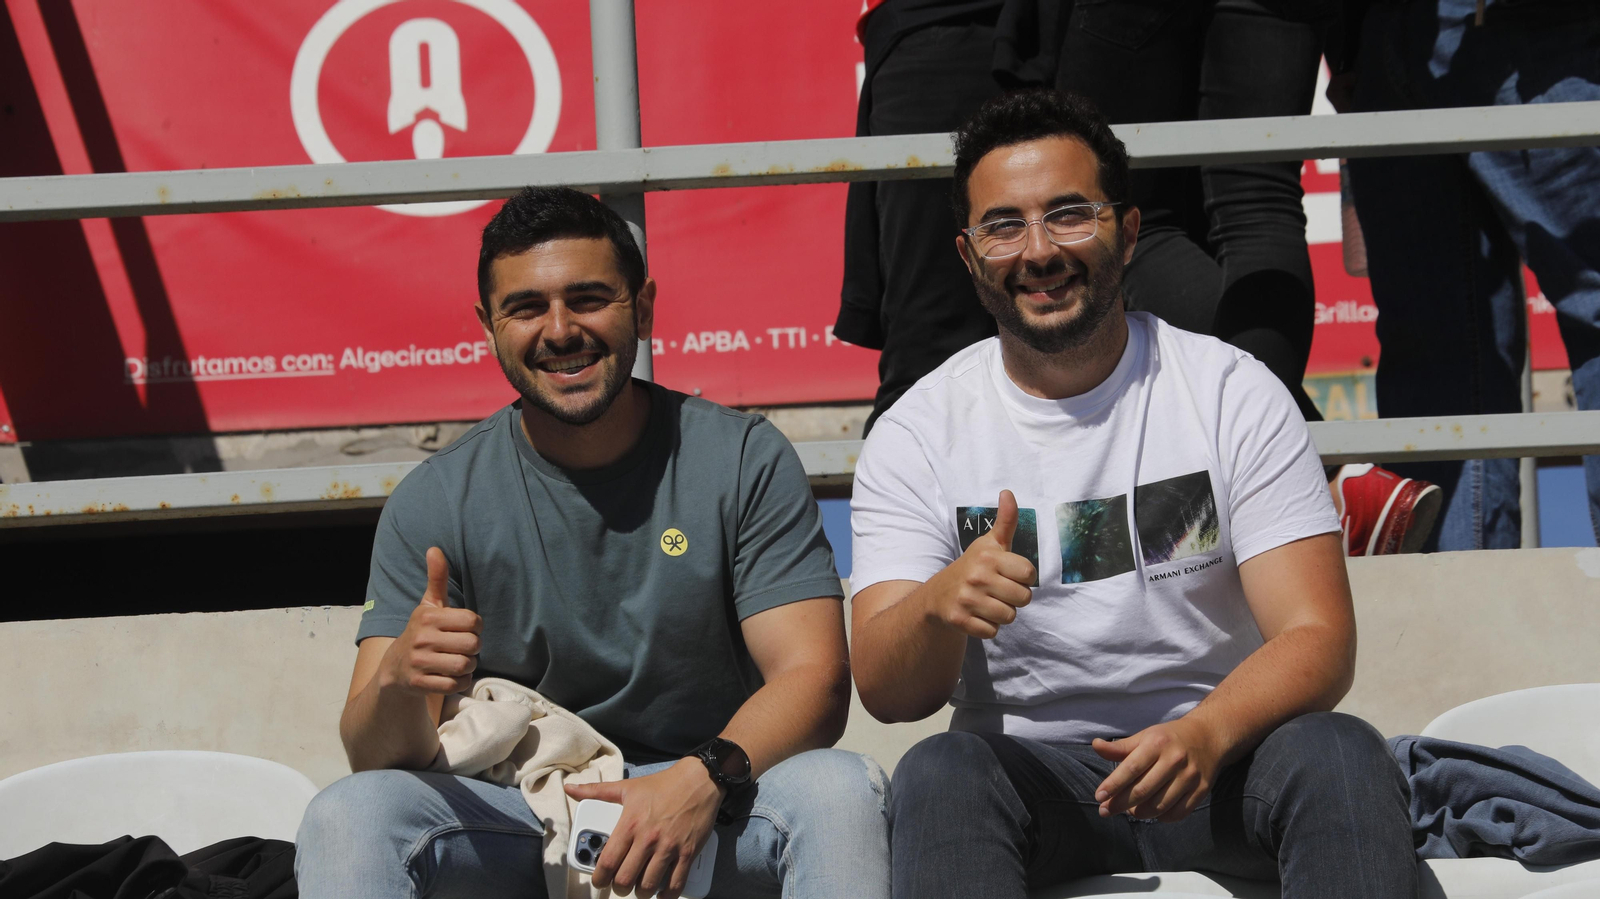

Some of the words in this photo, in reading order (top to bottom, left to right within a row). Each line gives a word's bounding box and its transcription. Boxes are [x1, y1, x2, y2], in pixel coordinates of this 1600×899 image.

[124, 355, 277, 379] Disfrutamos
[281, 353, 334, 372] con:
[339, 341, 489, 374] AlgecirasCF
[682, 329, 751, 354] APBA
[766, 326, 807, 349] TTI
[1149, 569, 1182, 583] ARMANI
[1184, 556, 1224, 575] EXCHANGE
